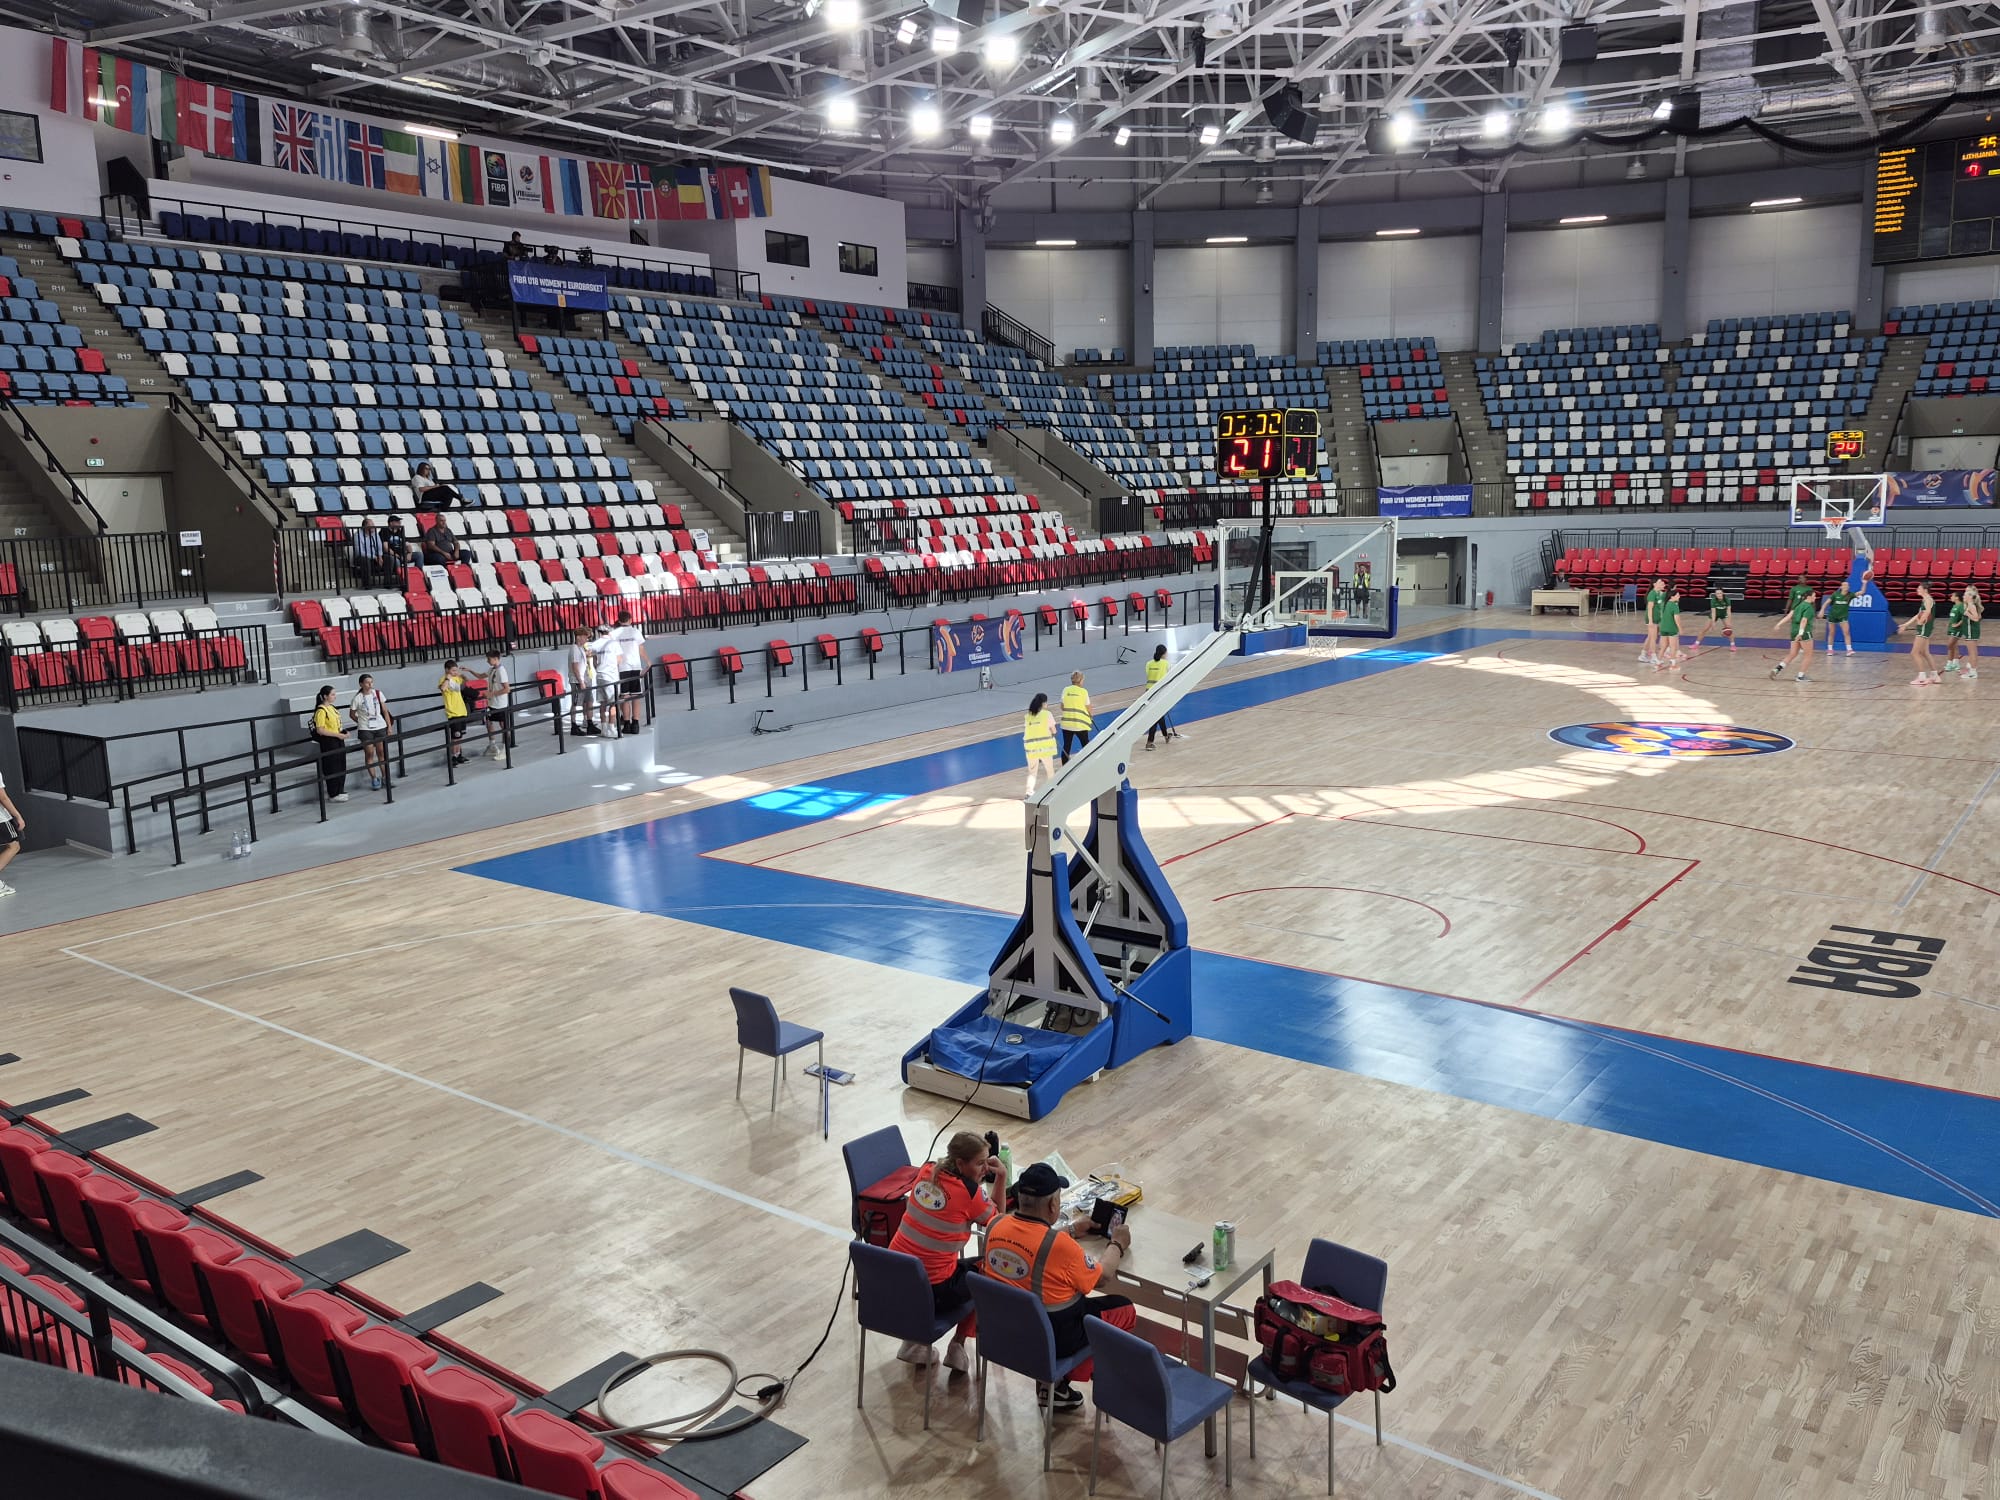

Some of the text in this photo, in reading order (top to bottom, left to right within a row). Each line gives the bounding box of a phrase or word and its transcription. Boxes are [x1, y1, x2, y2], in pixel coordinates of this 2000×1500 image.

[1961, 150, 1998, 161] LITHUANIA
[491, 182, 507, 193] FIBA
[30, 258, 45, 266] R17
[513, 275, 527, 285] FIBA
[527, 277, 539, 286] U18
[539, 278, 567, 289] WOMEN'S
[567, 281, 604, 293] EUROBASKET
[72, 305, 87, 313] R15
[94, 329, 109, 337] R14
[15, 528, 27, 536] R7
[235, 603, 248, 611] R4
[285, 668, 297, 676] R2
[1787, 925, 1946, 998] FIBA
